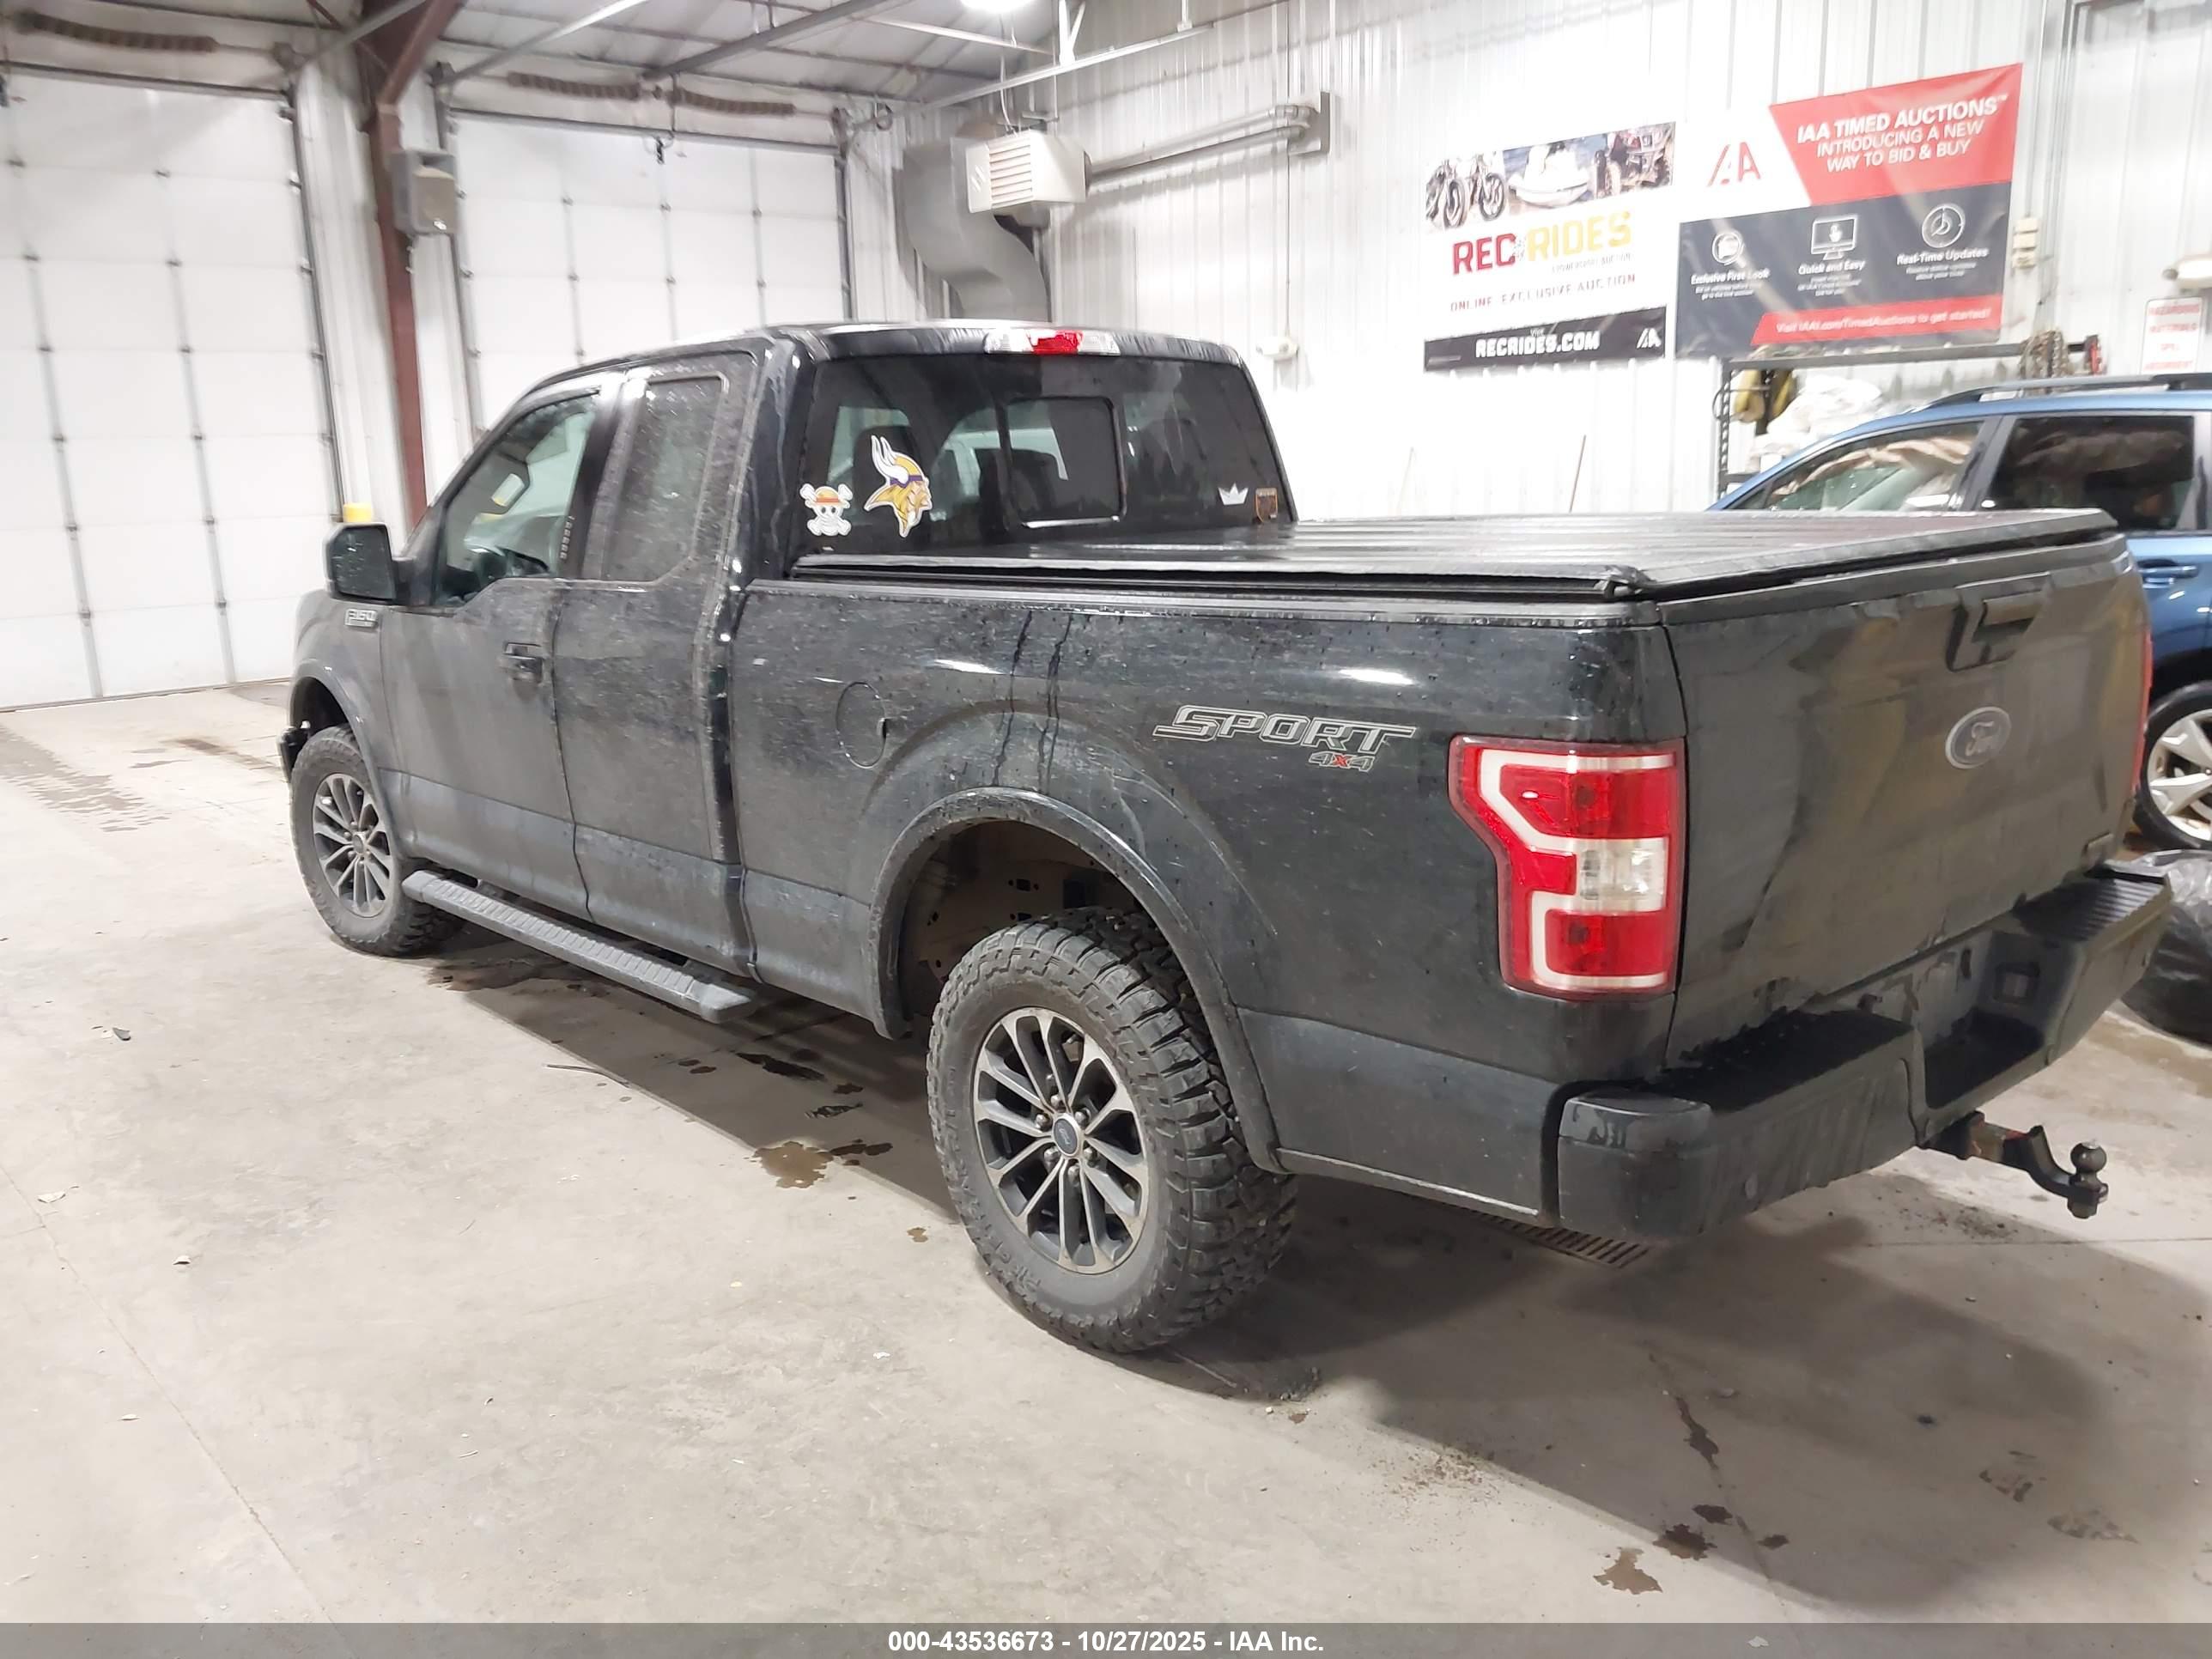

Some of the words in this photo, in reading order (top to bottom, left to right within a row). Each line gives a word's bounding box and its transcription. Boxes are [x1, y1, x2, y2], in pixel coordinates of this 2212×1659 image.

[1797, 122, 1831, 143] IAA
[1834, 112, 1889, 138] TIMED
[1817, 127, 1923, 157] INTRODUCING
[1927, 126, 1938, 141] A
[1943, 119, 1985, 138] NEW
[1826, 153, 1863, 173] WAY
[1864, 151, 1883, 167] TO
[1889, 146, 1914, 164] BID
[1919, 145, 1931, 159] &
[1936, 139, 1971, 158] BUY
[1798, 263, 1825, 275] Quick
[1826, 262, 1843, 272] and
[1844, 259, 1865, 270] Easy
[1897, 251, 1944, 265] Real-Time
[1945, 247, 1989, 260] Updates
[1450, 296, 1492, 312] ONLINE
[1502, 284, 1571, 304] EXCLUSIVE
[1577, 274, 1635, 291] AUCTION
[1691, 272, 1726, 285] Exclusive
[1727, 270, 1745, 281] First
[1475, 331, 1601, 358] RECRIDES.COM
[1152, 704, 1416, 755] SPORT
